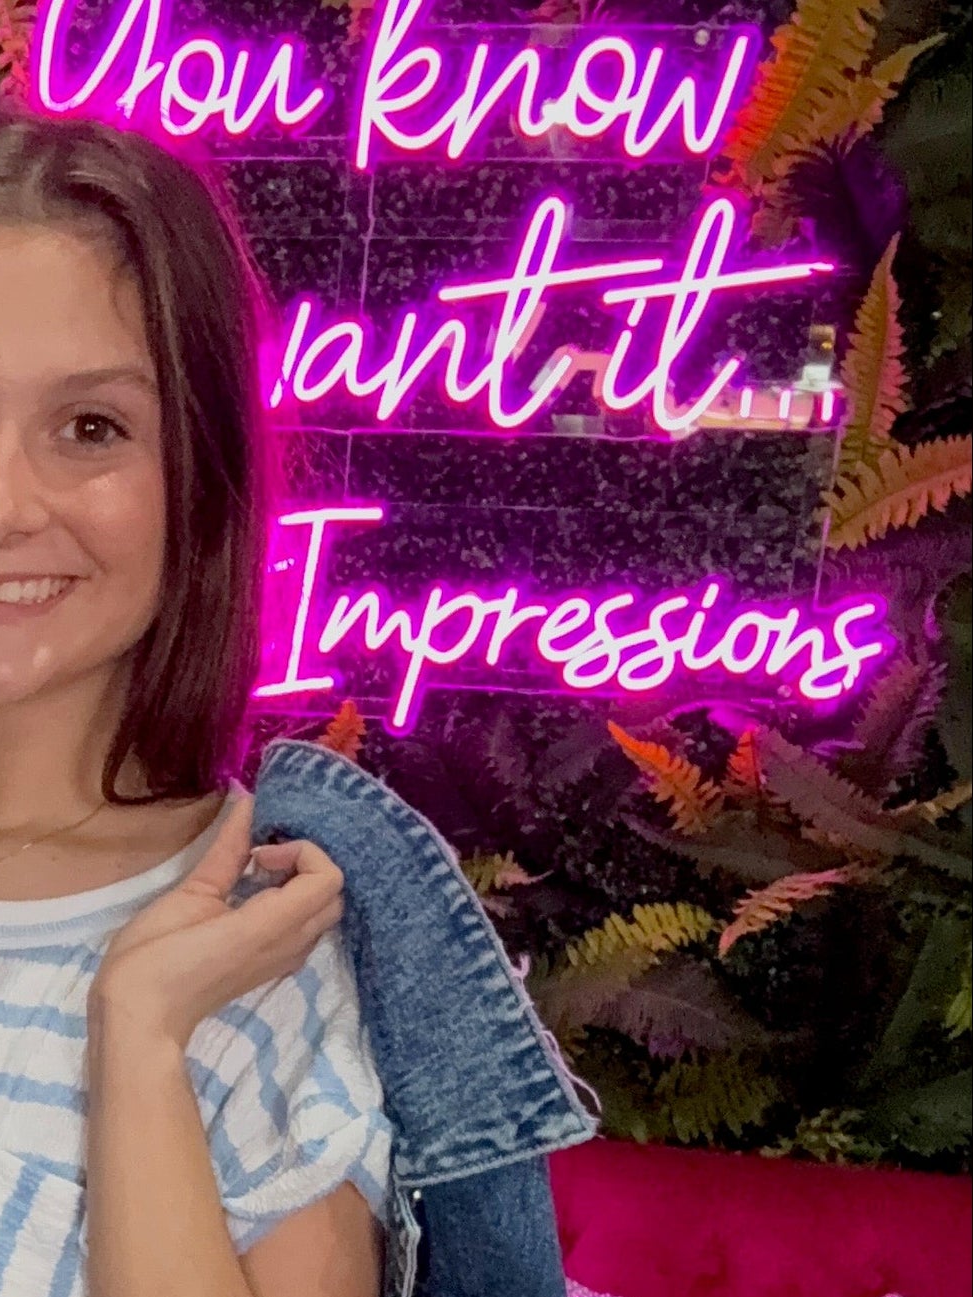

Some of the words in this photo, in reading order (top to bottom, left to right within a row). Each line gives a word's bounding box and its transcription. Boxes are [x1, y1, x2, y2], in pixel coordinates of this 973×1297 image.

[38, 0, 323, 135] You
[358, 0, 749, 168] know
[270, 197, 663, 428] ant
[255, 507, 883, 729] Impressions
